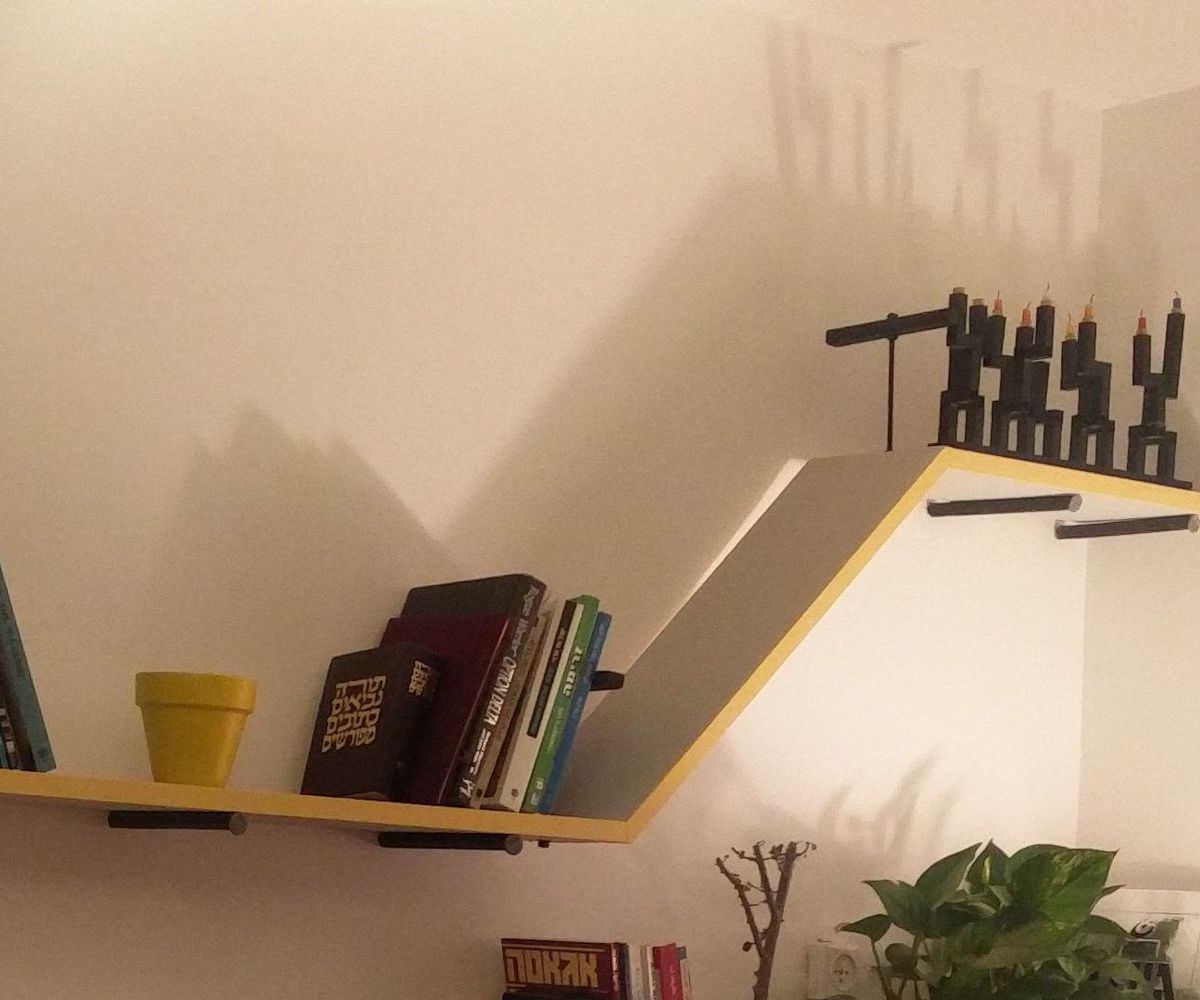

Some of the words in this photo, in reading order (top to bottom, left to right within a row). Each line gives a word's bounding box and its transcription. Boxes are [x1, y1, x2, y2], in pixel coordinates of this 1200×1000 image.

[492, 655, 518, 697] OPTION
[558, 645, 587, 697] זרימה
[336, 675, 386, 699] תורה
[331, 690, 383, 717] נביאים
[482, 692, 505, 726] DELTA
[326, 708, 380, 735] כתובים
[321, 726, 377, 753] מפורשים
